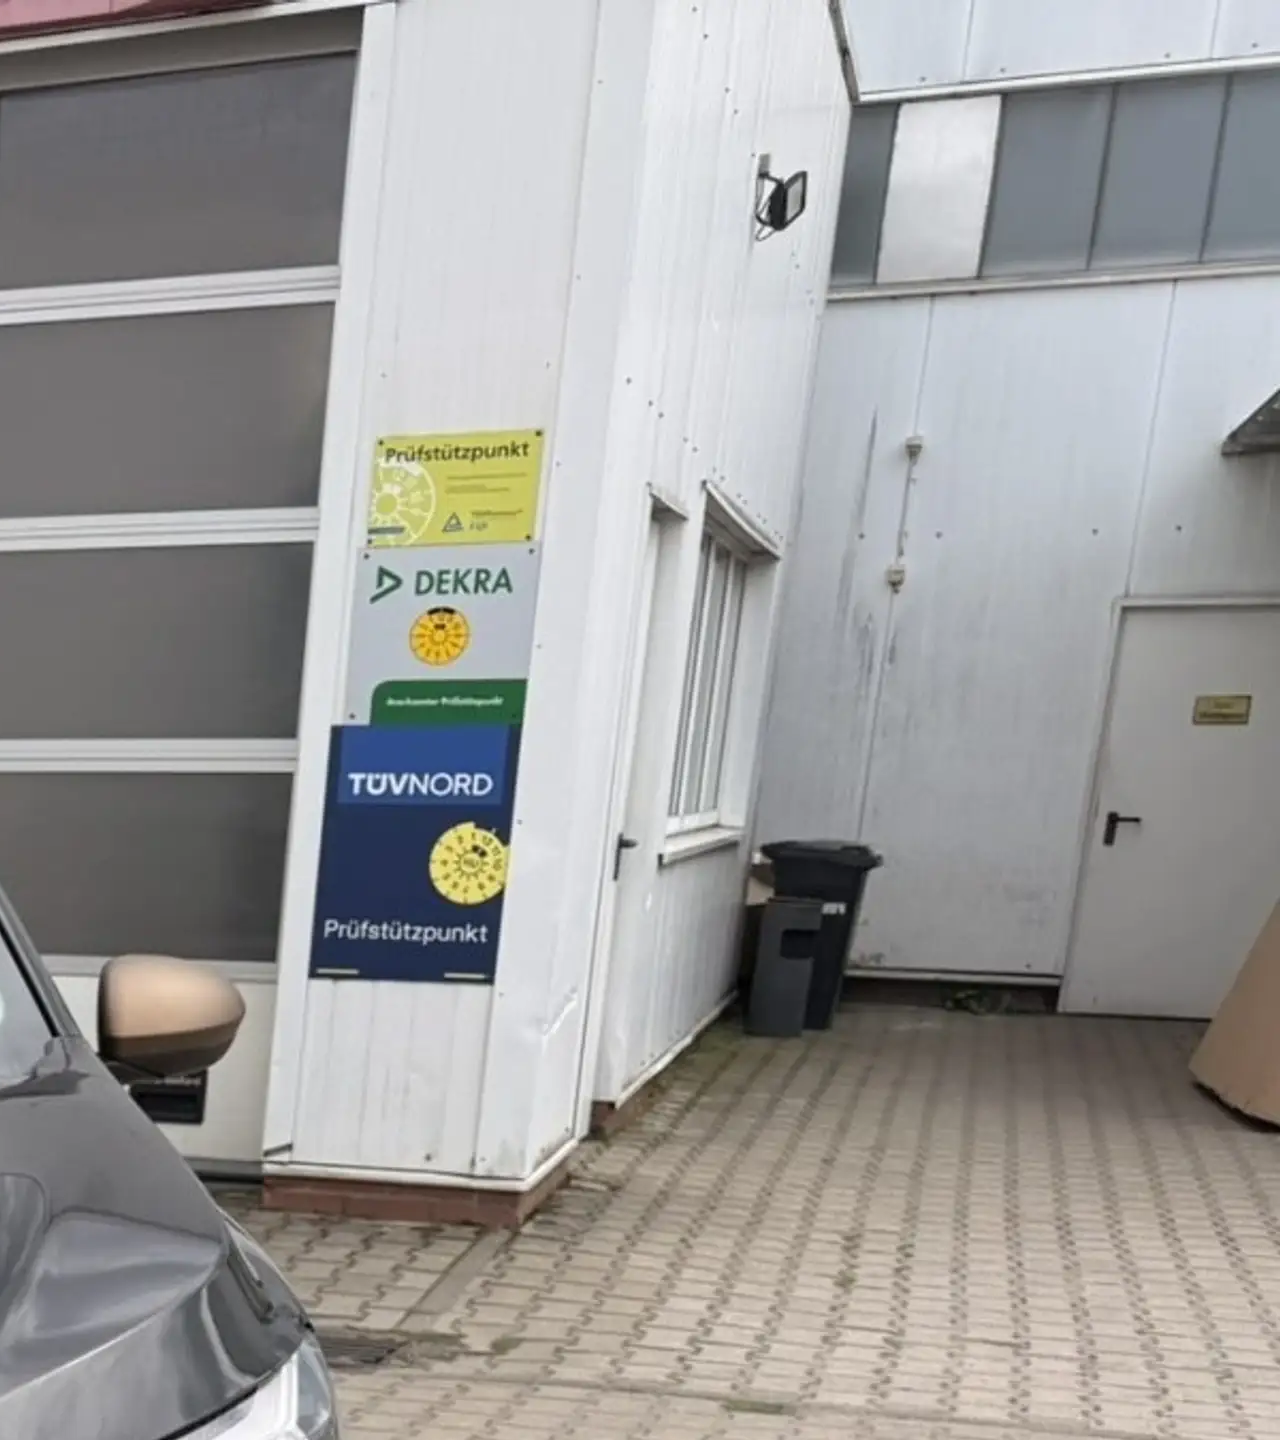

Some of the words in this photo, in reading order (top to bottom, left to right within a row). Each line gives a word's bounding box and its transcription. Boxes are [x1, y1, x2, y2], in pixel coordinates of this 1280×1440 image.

[385, 440, 530, 463] Prüfstützpunkt
[414, 567, 514, 597] DEKRA
[323, 919, 489, 946] Prüfstützpunkt
